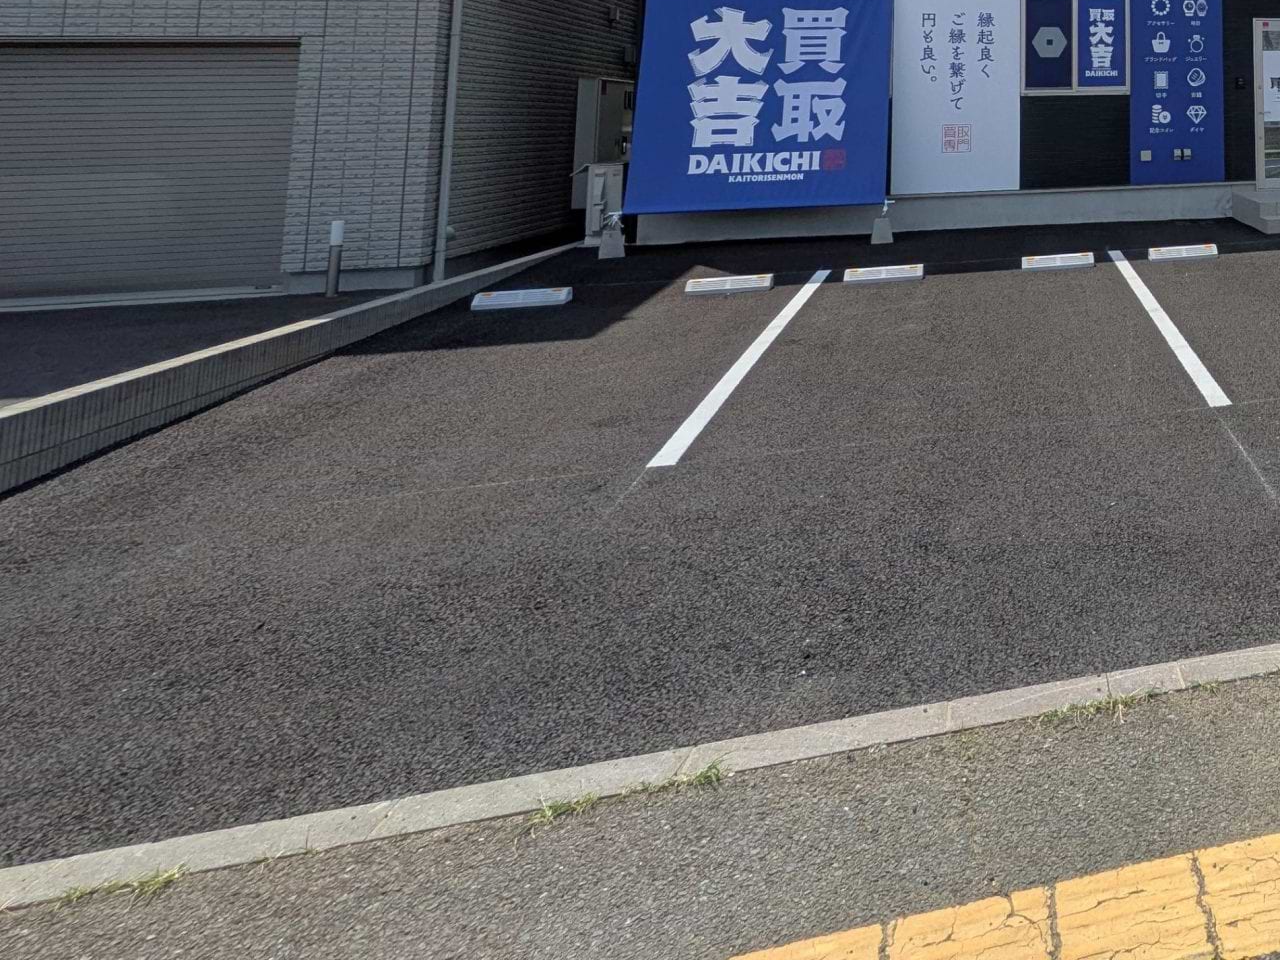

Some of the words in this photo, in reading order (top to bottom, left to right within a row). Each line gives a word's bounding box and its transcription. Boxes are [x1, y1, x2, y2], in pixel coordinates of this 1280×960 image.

[920, 13, 938, 82] 円も良い。
[948, 12, 967, 110] ご縁を繋げて
[977, 12, 996, 78] 縁起良く
[687, 150, 821, 175] DAIKICHI
[728, 173, 804, 183] KAITORISENMON
